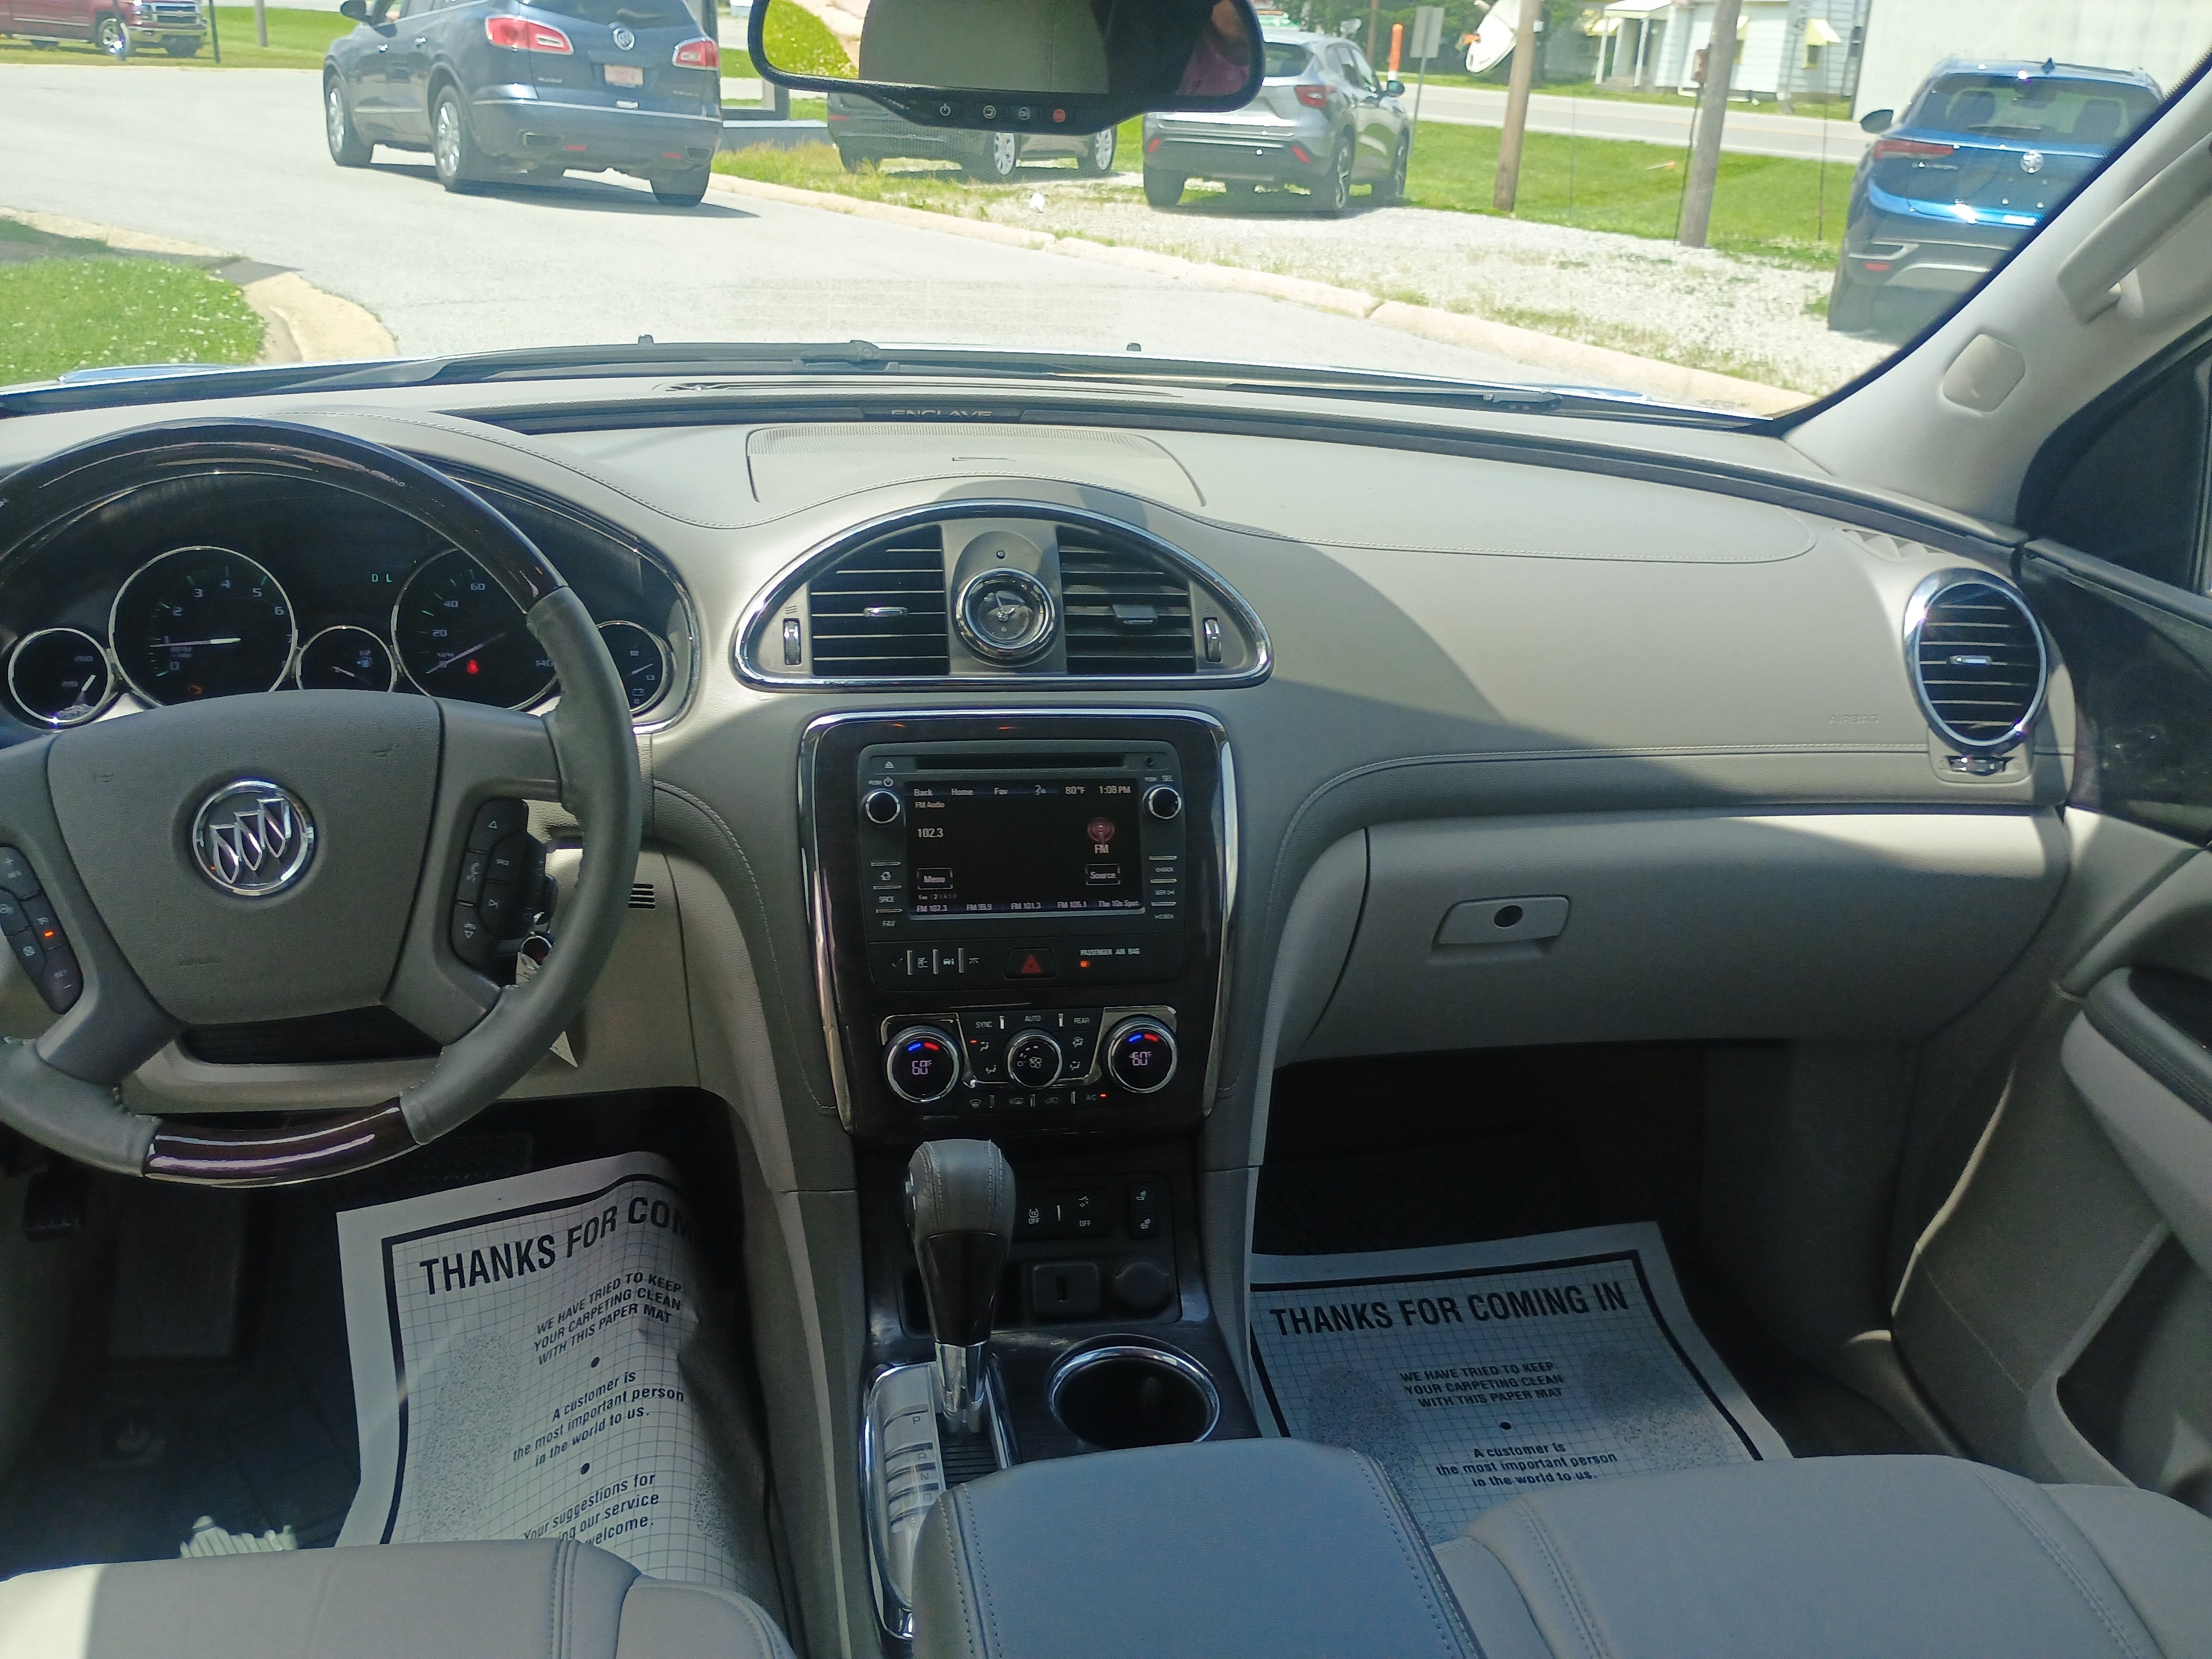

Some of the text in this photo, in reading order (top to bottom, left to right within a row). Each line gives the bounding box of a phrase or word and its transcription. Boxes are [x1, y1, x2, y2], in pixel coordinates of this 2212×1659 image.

[194, 588, 204, 598] 3
[252, 588, 263, 598] 5
[172, 606, 184, 617] 2
[274, 606, 285, 616] 6
[431, 629, 448, 637] 20
[914, 788, 933, 797] Back
[951, 787, 974, 795] Home
[994, 787, 1009, 795] Fav
[1118, 785, 1131, 794] PM
[917, 827, 944, 838] 102.3
[1094, 844, 1109, 854] FM
[1089, 871, 1117, 880] Source
[975, 1021, 993, 1029] SYNC
[1078, 1219, 1092, 1228] OFF
[420, 1234, 556, 1295] THANKS
[566, 1205, 618, 1258] FOR
[537, 1272, 682, 1334] WE HAVE TRIED TO KEEP
[1270, 1281, 1629, 1336] THANKS FOR COMING IN
[534, 1287, 682, 1352] YOUR CARPETING CLEAN
[538, 1303, 673, 1366] WITH THIS PAPER MAT
[1399, 1361, 1554, 1382] WE HAVE TRIED TO KEEP
[1404, 1374, 1564, 1395] YOUR CARPETING CLEAN
[552, 1371, 637, 1422] A customer is
[1417, 1387, 1563, 1408] WITH THIS PAPER MAT
[513, 1387, 685, 1461] the most important person
[913, 1416, 921, 1425] P
[535, 1406, 650, 1468] in the world to us.
[1474, 1442, 1566, 1459] A customer is
[1435, 1453, 1618, 1476] the most important person
[1472, 1471, 1598, 1487] in the world to us.
[552, 1479, 629, 1529] suggestions
[633, 1473, 656, 1488] for
[579, 1512, 601, 1532] our
[604, 1493, 659, 1519] service
